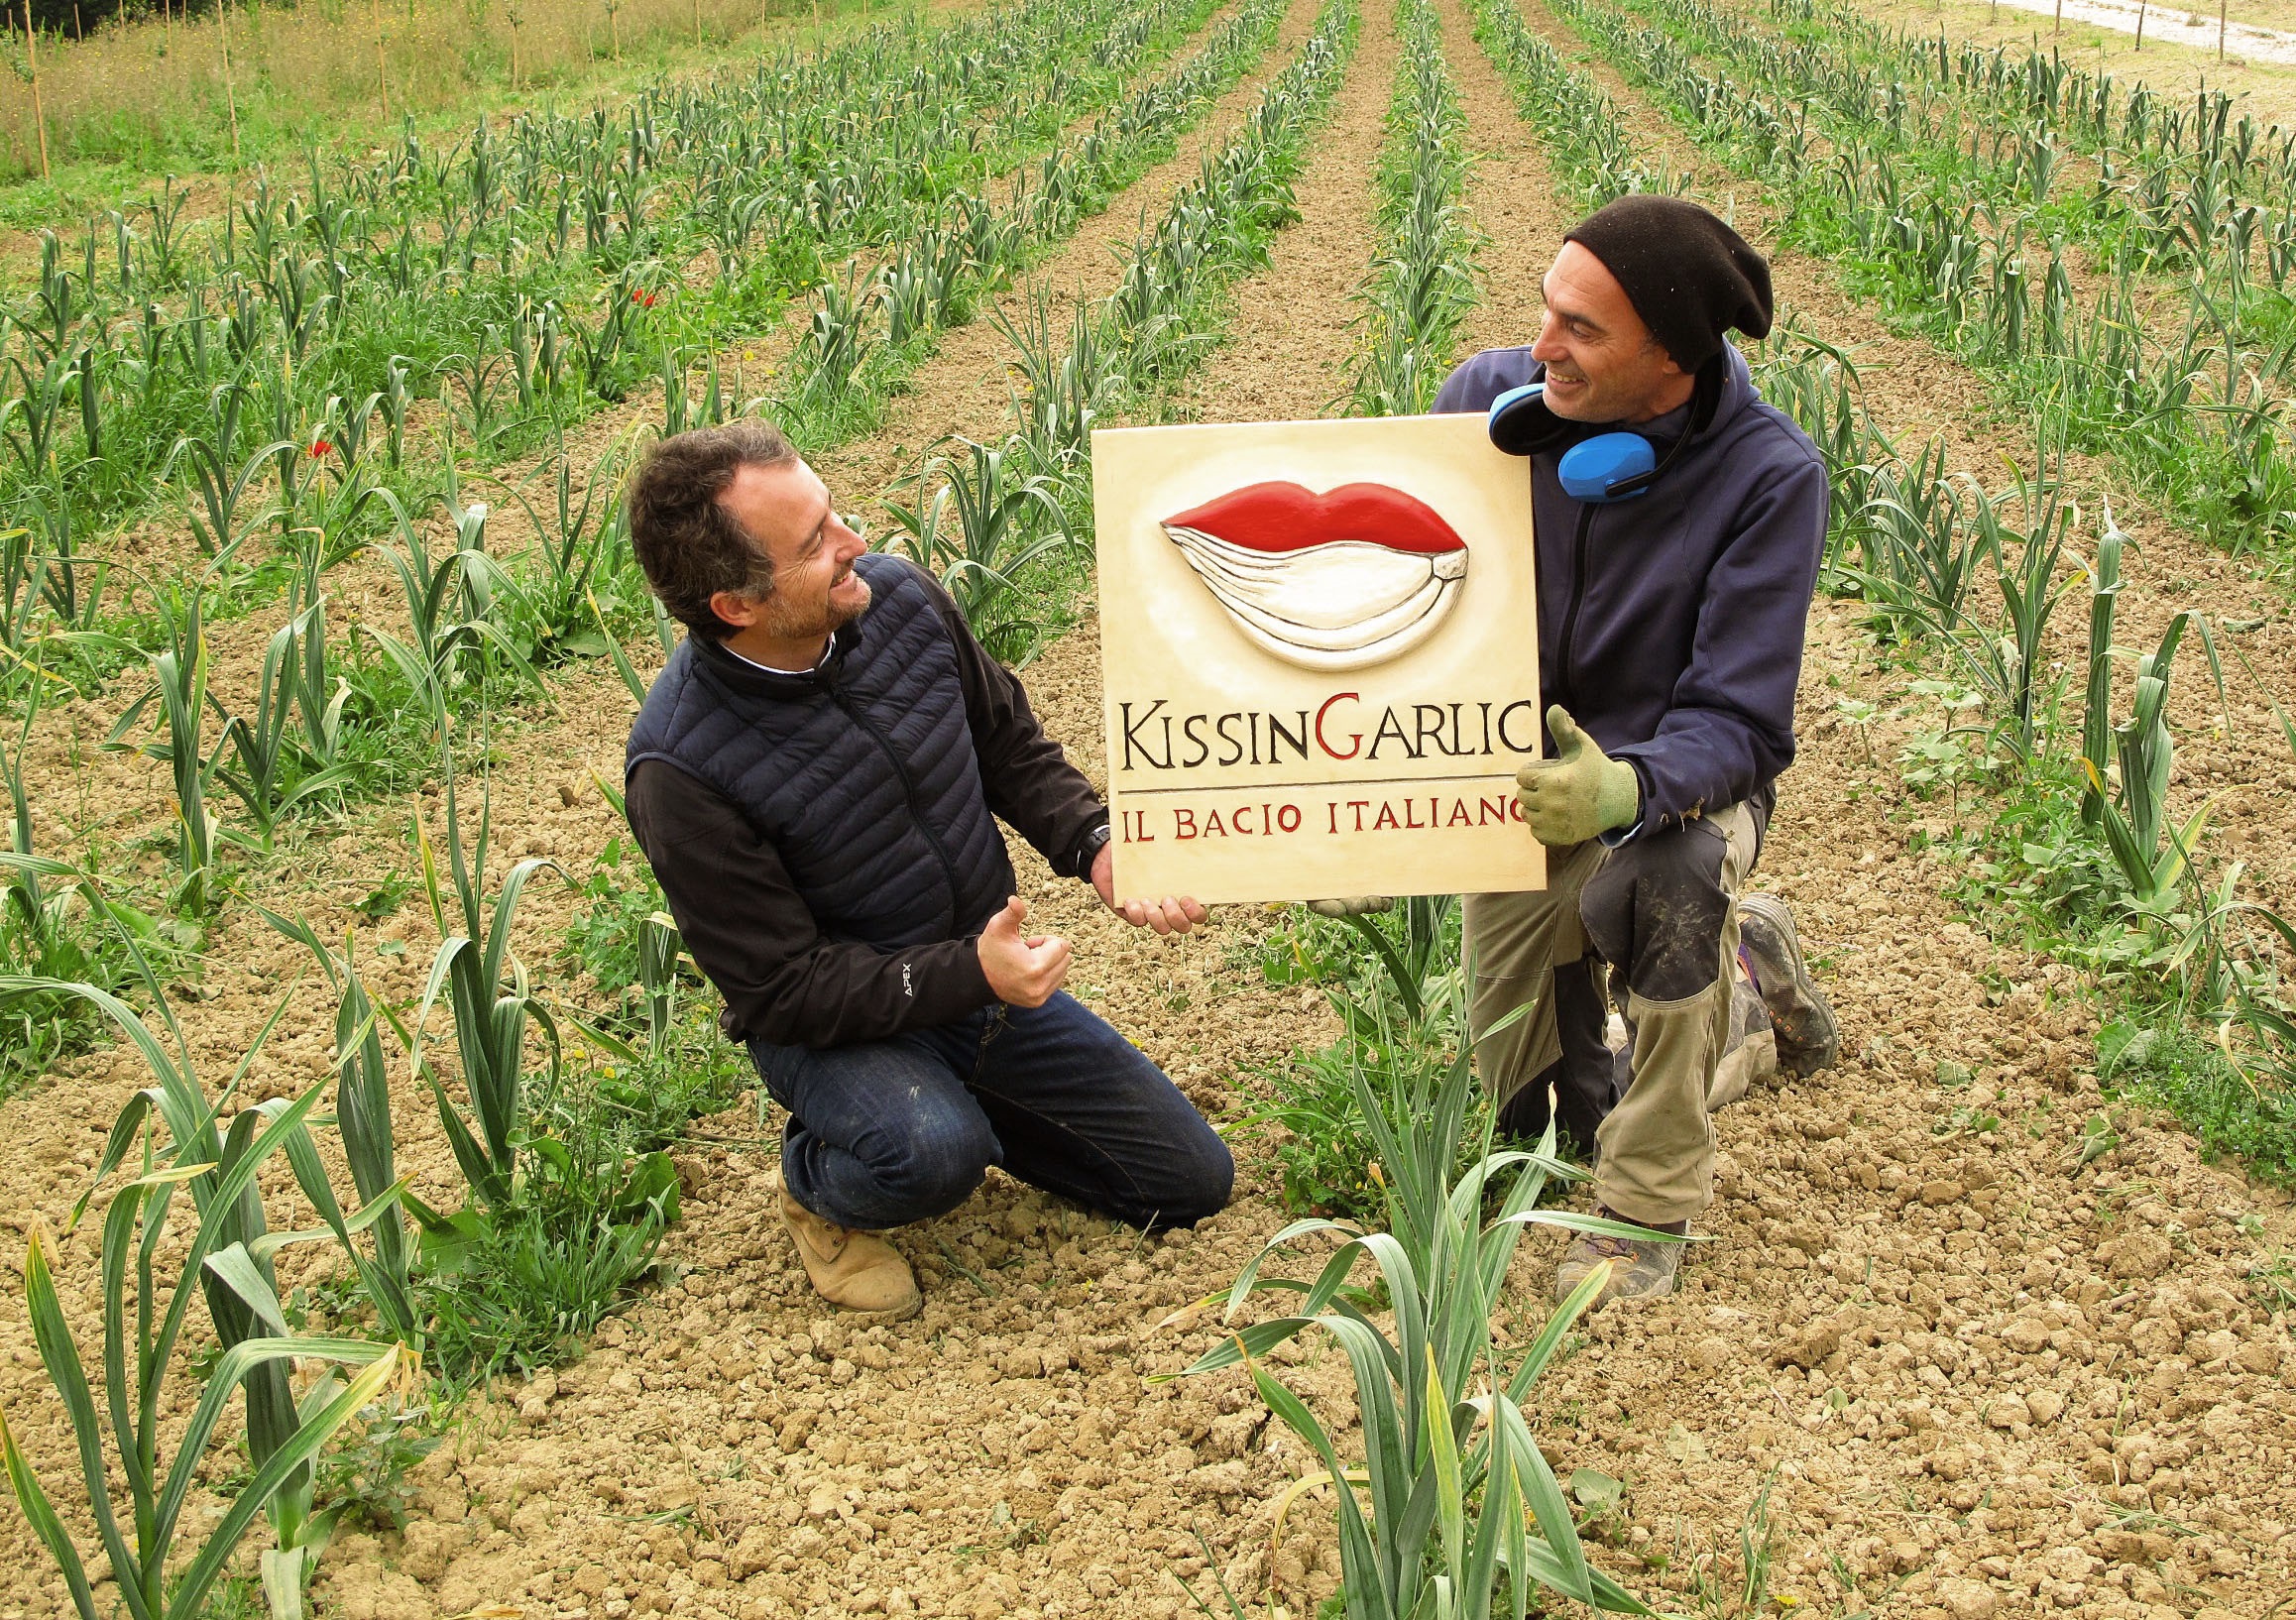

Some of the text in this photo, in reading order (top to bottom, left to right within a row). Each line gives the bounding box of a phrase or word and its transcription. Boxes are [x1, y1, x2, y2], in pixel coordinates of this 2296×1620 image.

[1121, 810, 1155, 844] IL
[1173, 803, 1302, 840] BACIO
[902, 963, 913, 997] APEX
